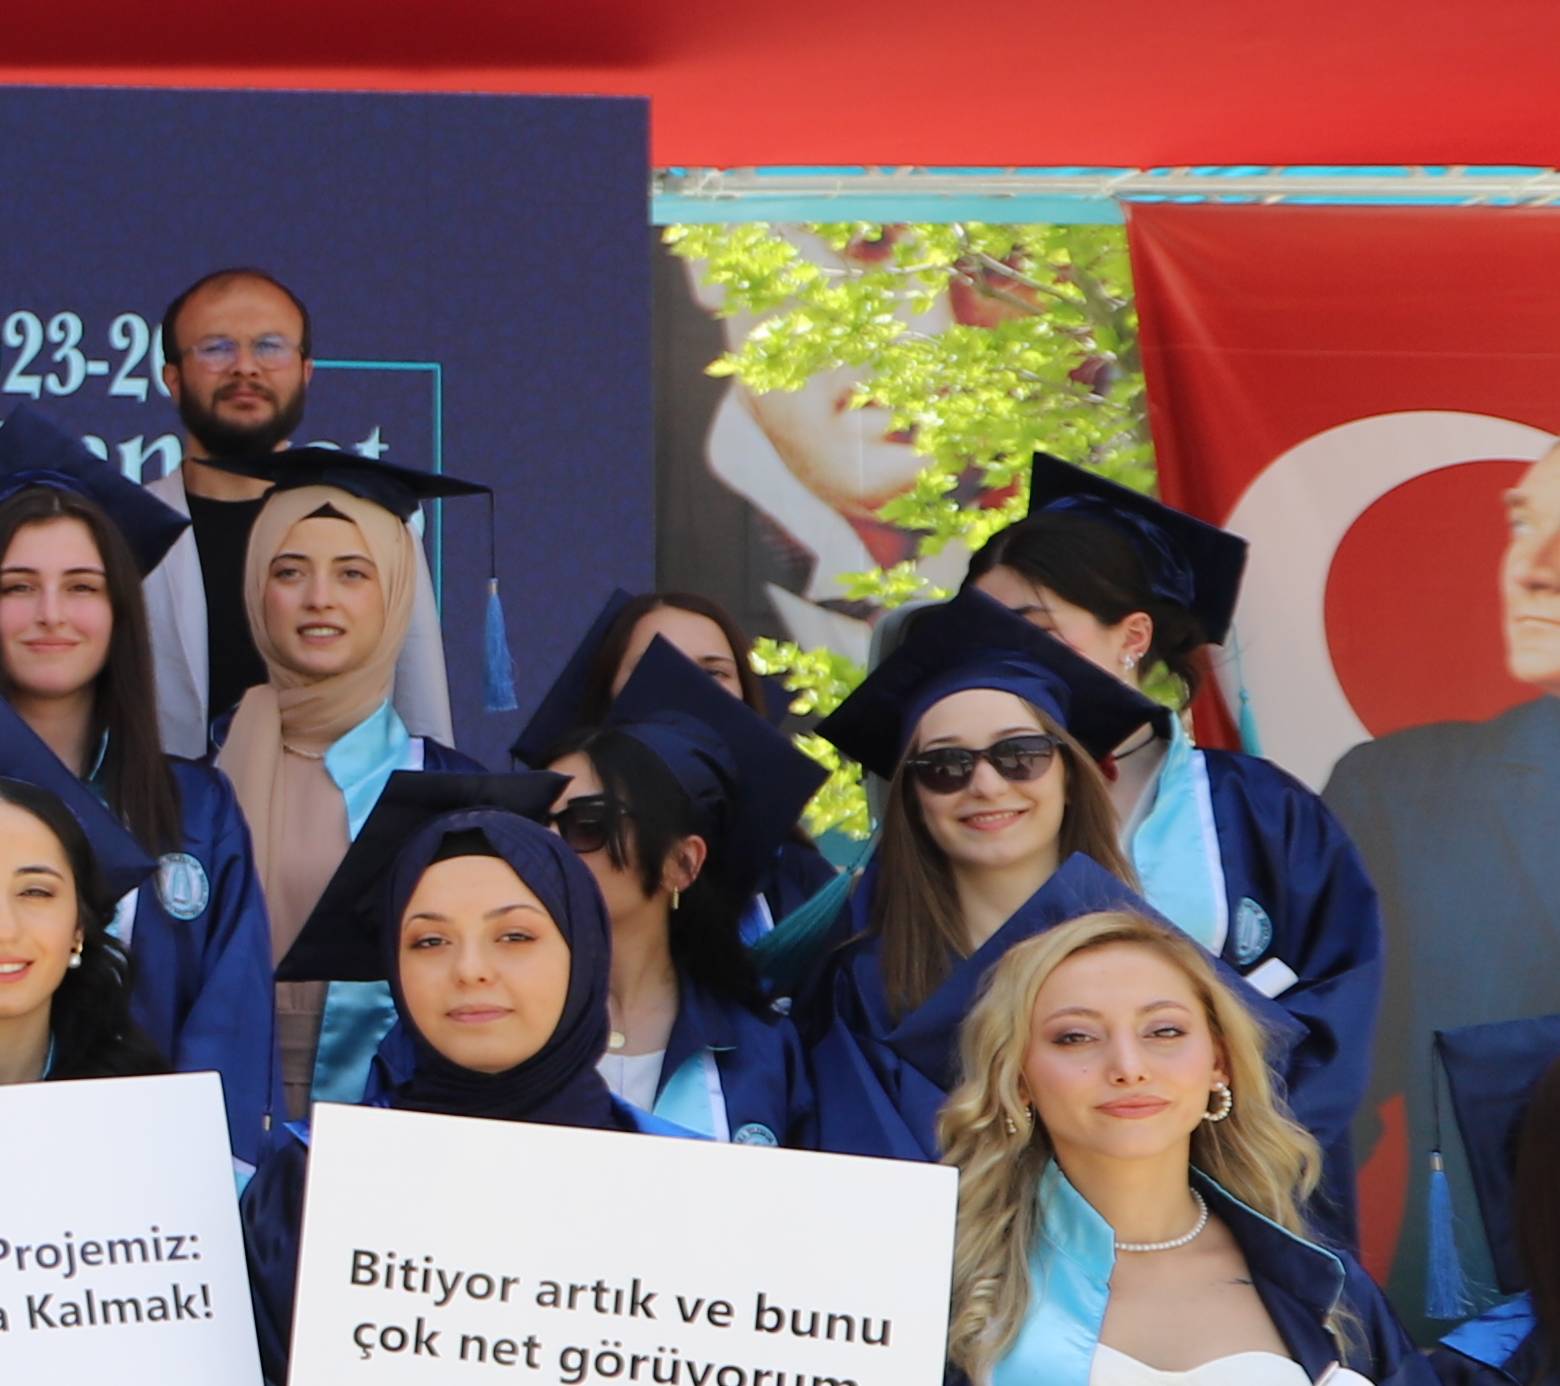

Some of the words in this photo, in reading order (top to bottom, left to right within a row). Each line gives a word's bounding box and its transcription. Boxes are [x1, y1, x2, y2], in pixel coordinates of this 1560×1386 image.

[26, 1284, 215, 1333] Kalmak!
[349, 1248, 520, 1307] Bitiyor
[534, 1277, 658, 1320] artık
[675, 1294, 734, 1328] ve
[754, 1292, 893, 1347] bunu
[352, 1317, 441, 1360] çok
[458, 1328, 541, 1370] net
